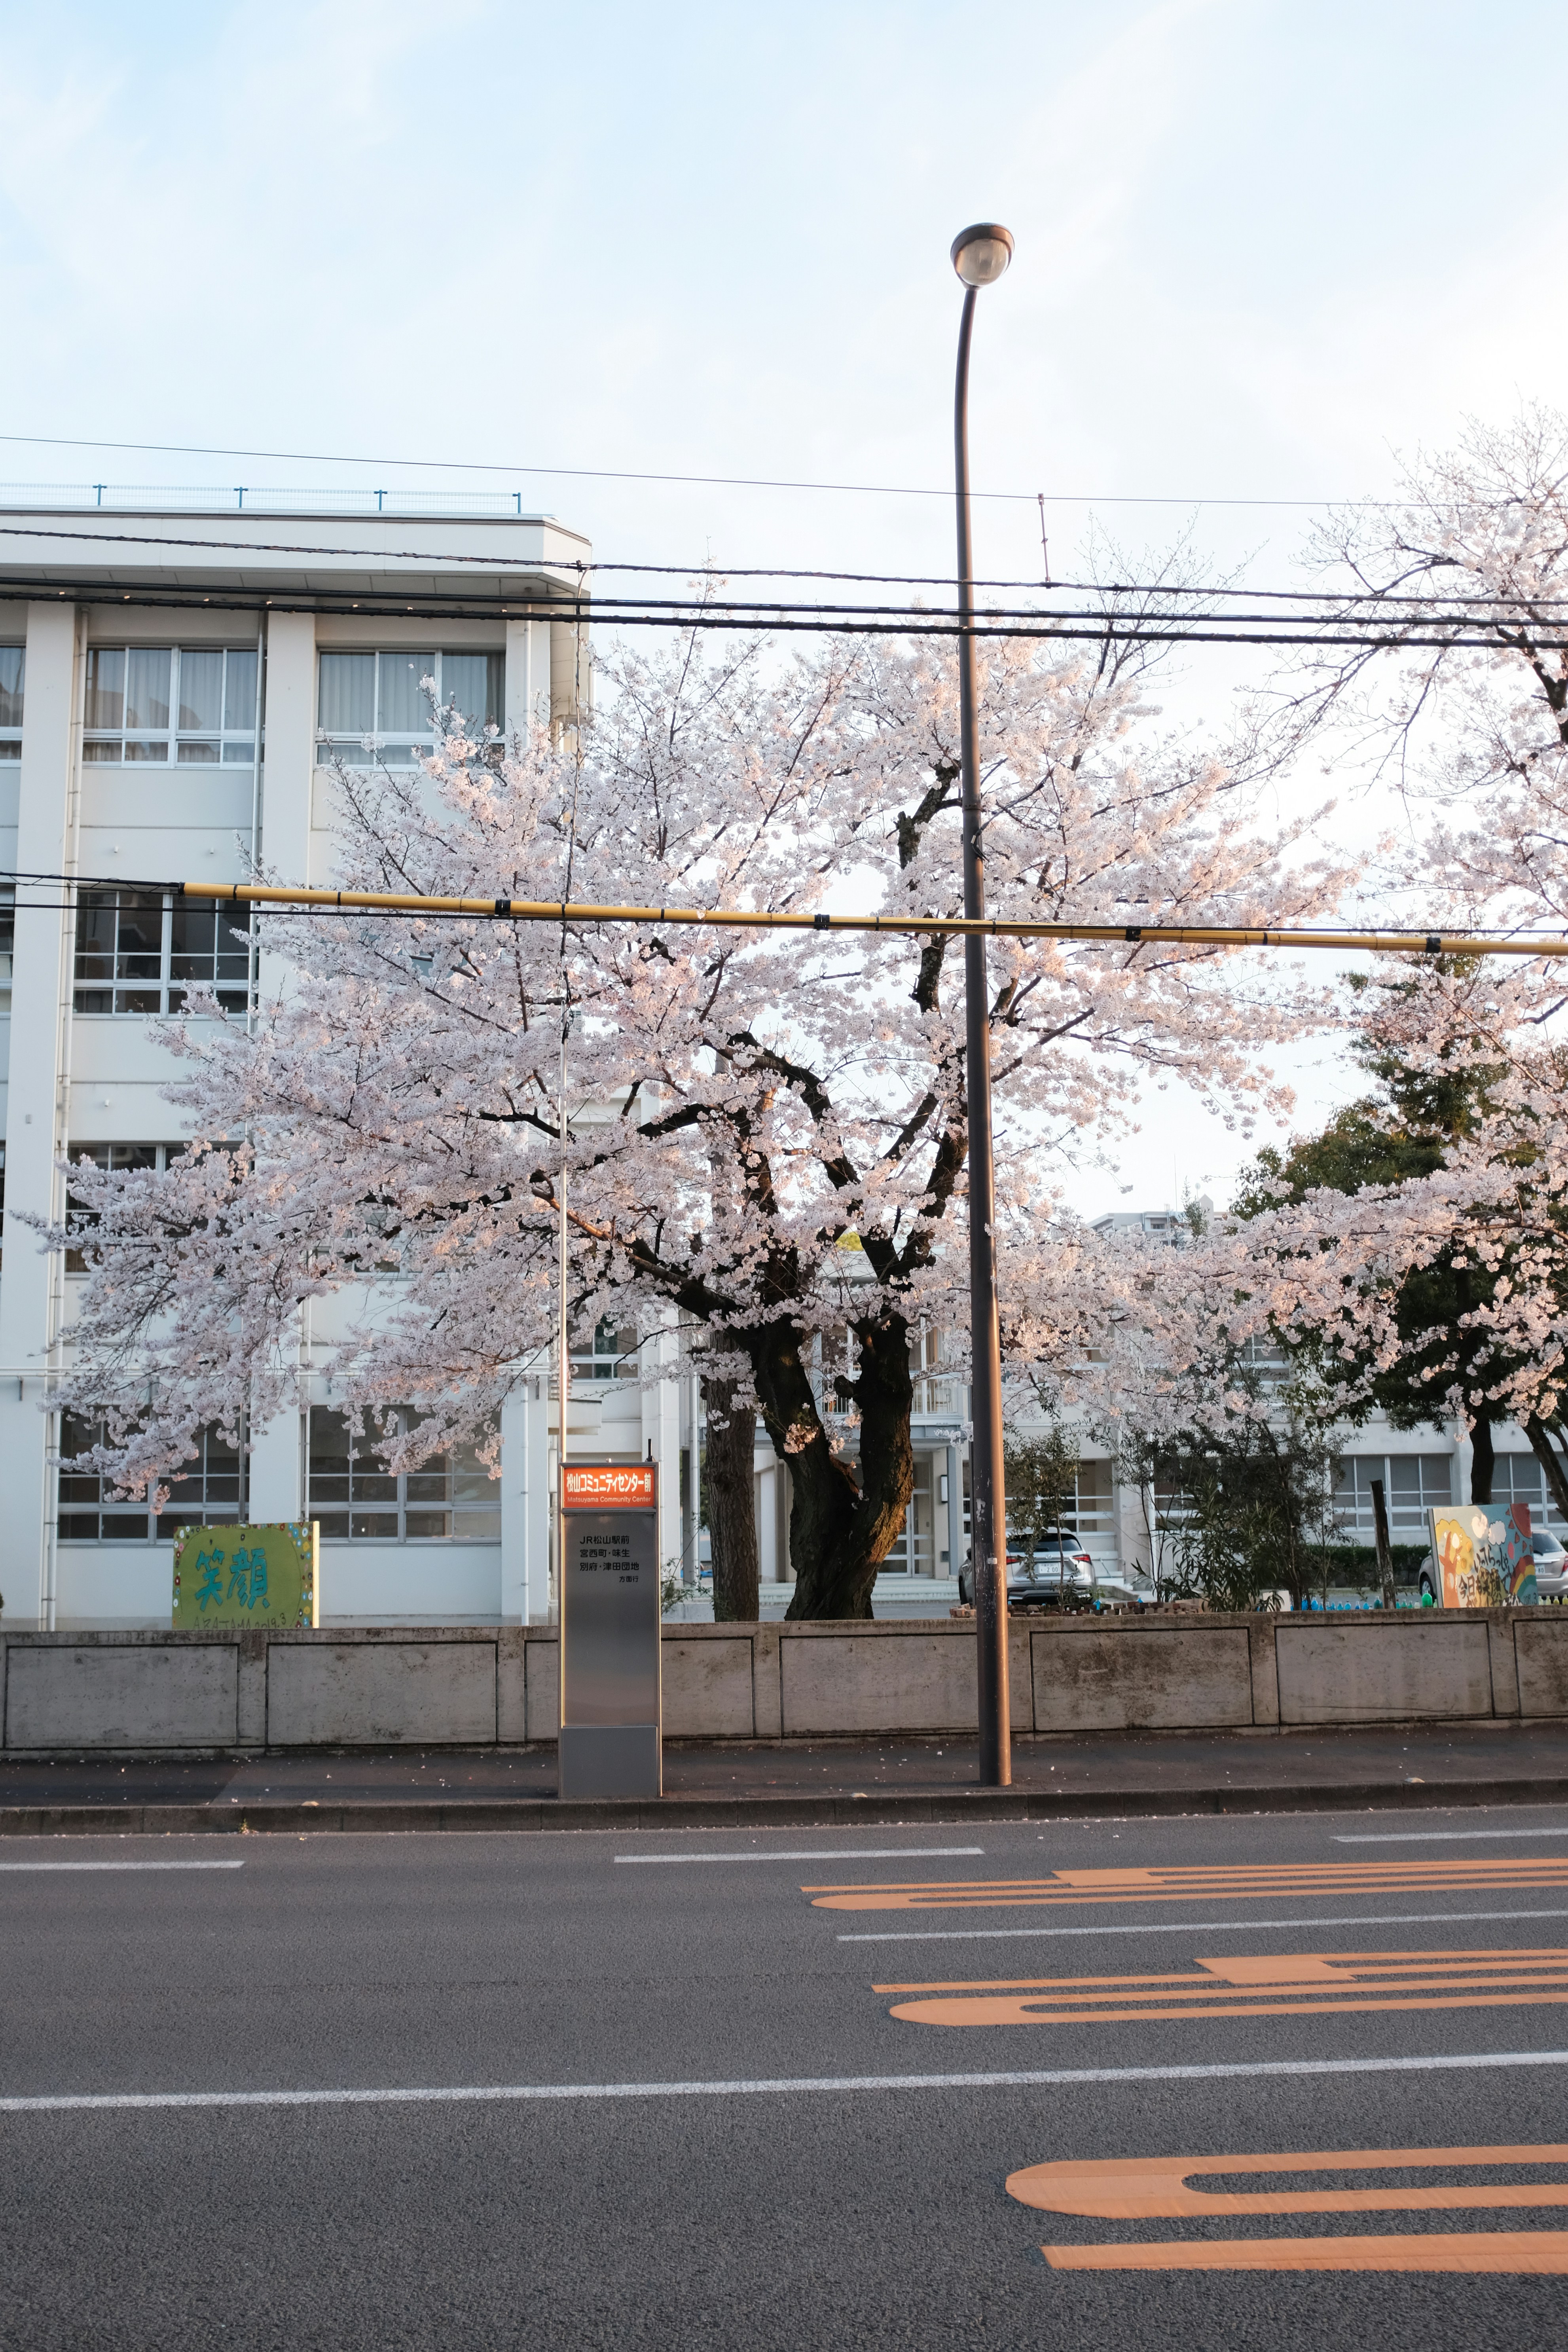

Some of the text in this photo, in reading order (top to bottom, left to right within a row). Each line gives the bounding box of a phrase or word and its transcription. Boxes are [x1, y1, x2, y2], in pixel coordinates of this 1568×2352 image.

[567, 1472, 651, 1493] 松山コミュニティセンター前
[580, 1535, 629, 1544] JR松山駅前
[194, 1546, 270, 1612] 笑顔
